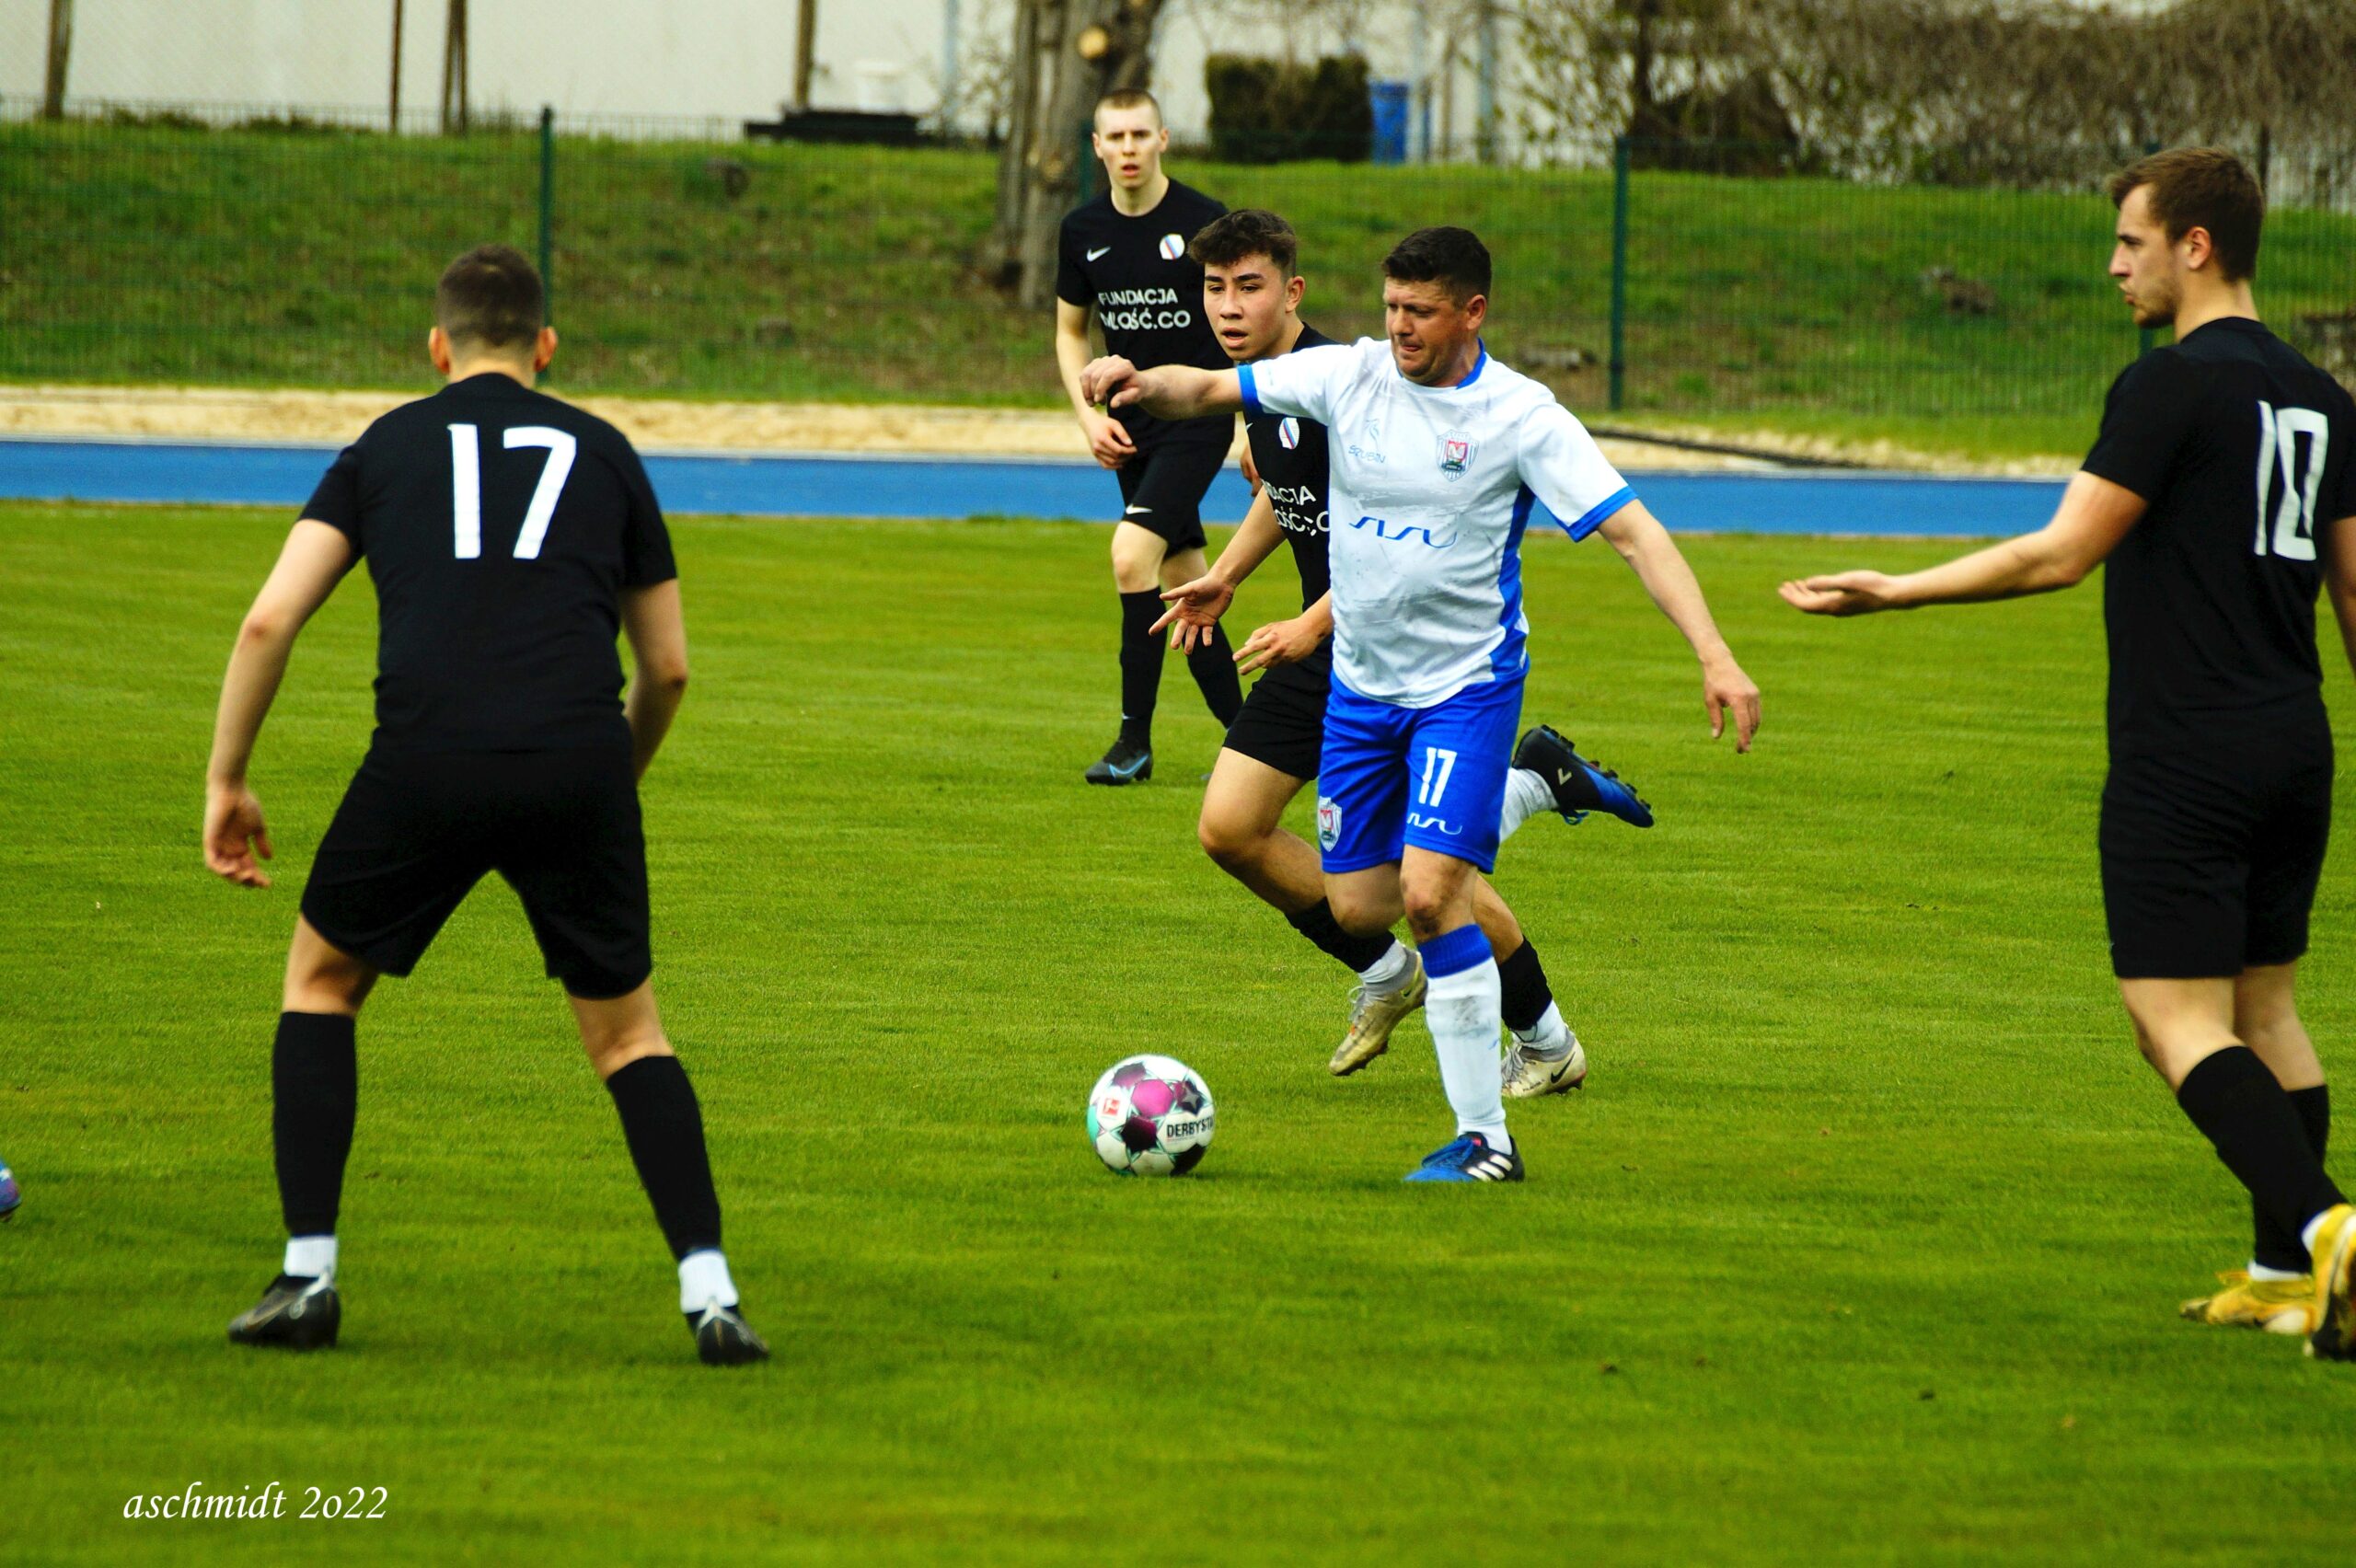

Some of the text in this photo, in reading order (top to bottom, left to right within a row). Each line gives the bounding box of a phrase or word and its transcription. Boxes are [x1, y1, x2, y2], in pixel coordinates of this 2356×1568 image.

[1098, 288, 1178, 306] FUNDACJA
[446, 423, 577, 559] 17
[2254, 399, 2328, 561] 10
[1418, 747, 1458, 808] 17
[1167, 1116, 1213, 1137] DERBYST
